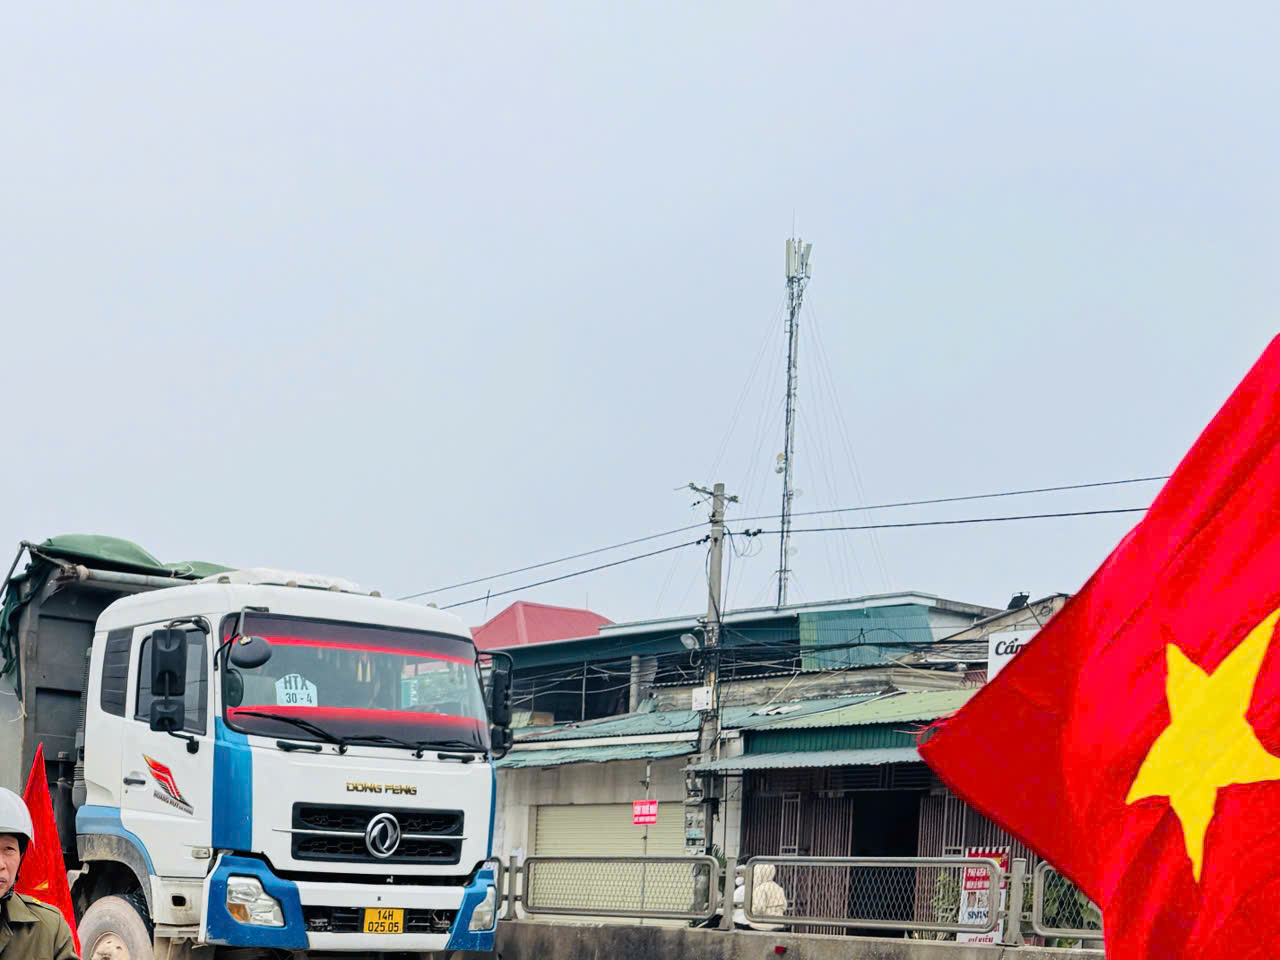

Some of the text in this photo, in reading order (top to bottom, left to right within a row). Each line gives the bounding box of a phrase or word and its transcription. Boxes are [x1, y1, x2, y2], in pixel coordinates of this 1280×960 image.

[283, 675, 309, 690] HTX
[285, 692, 297, 704] 30
[306, 693, 313, 704] 4
[384, 783, 417, 796] FENG
[377, 910, 394, 921] 14H
